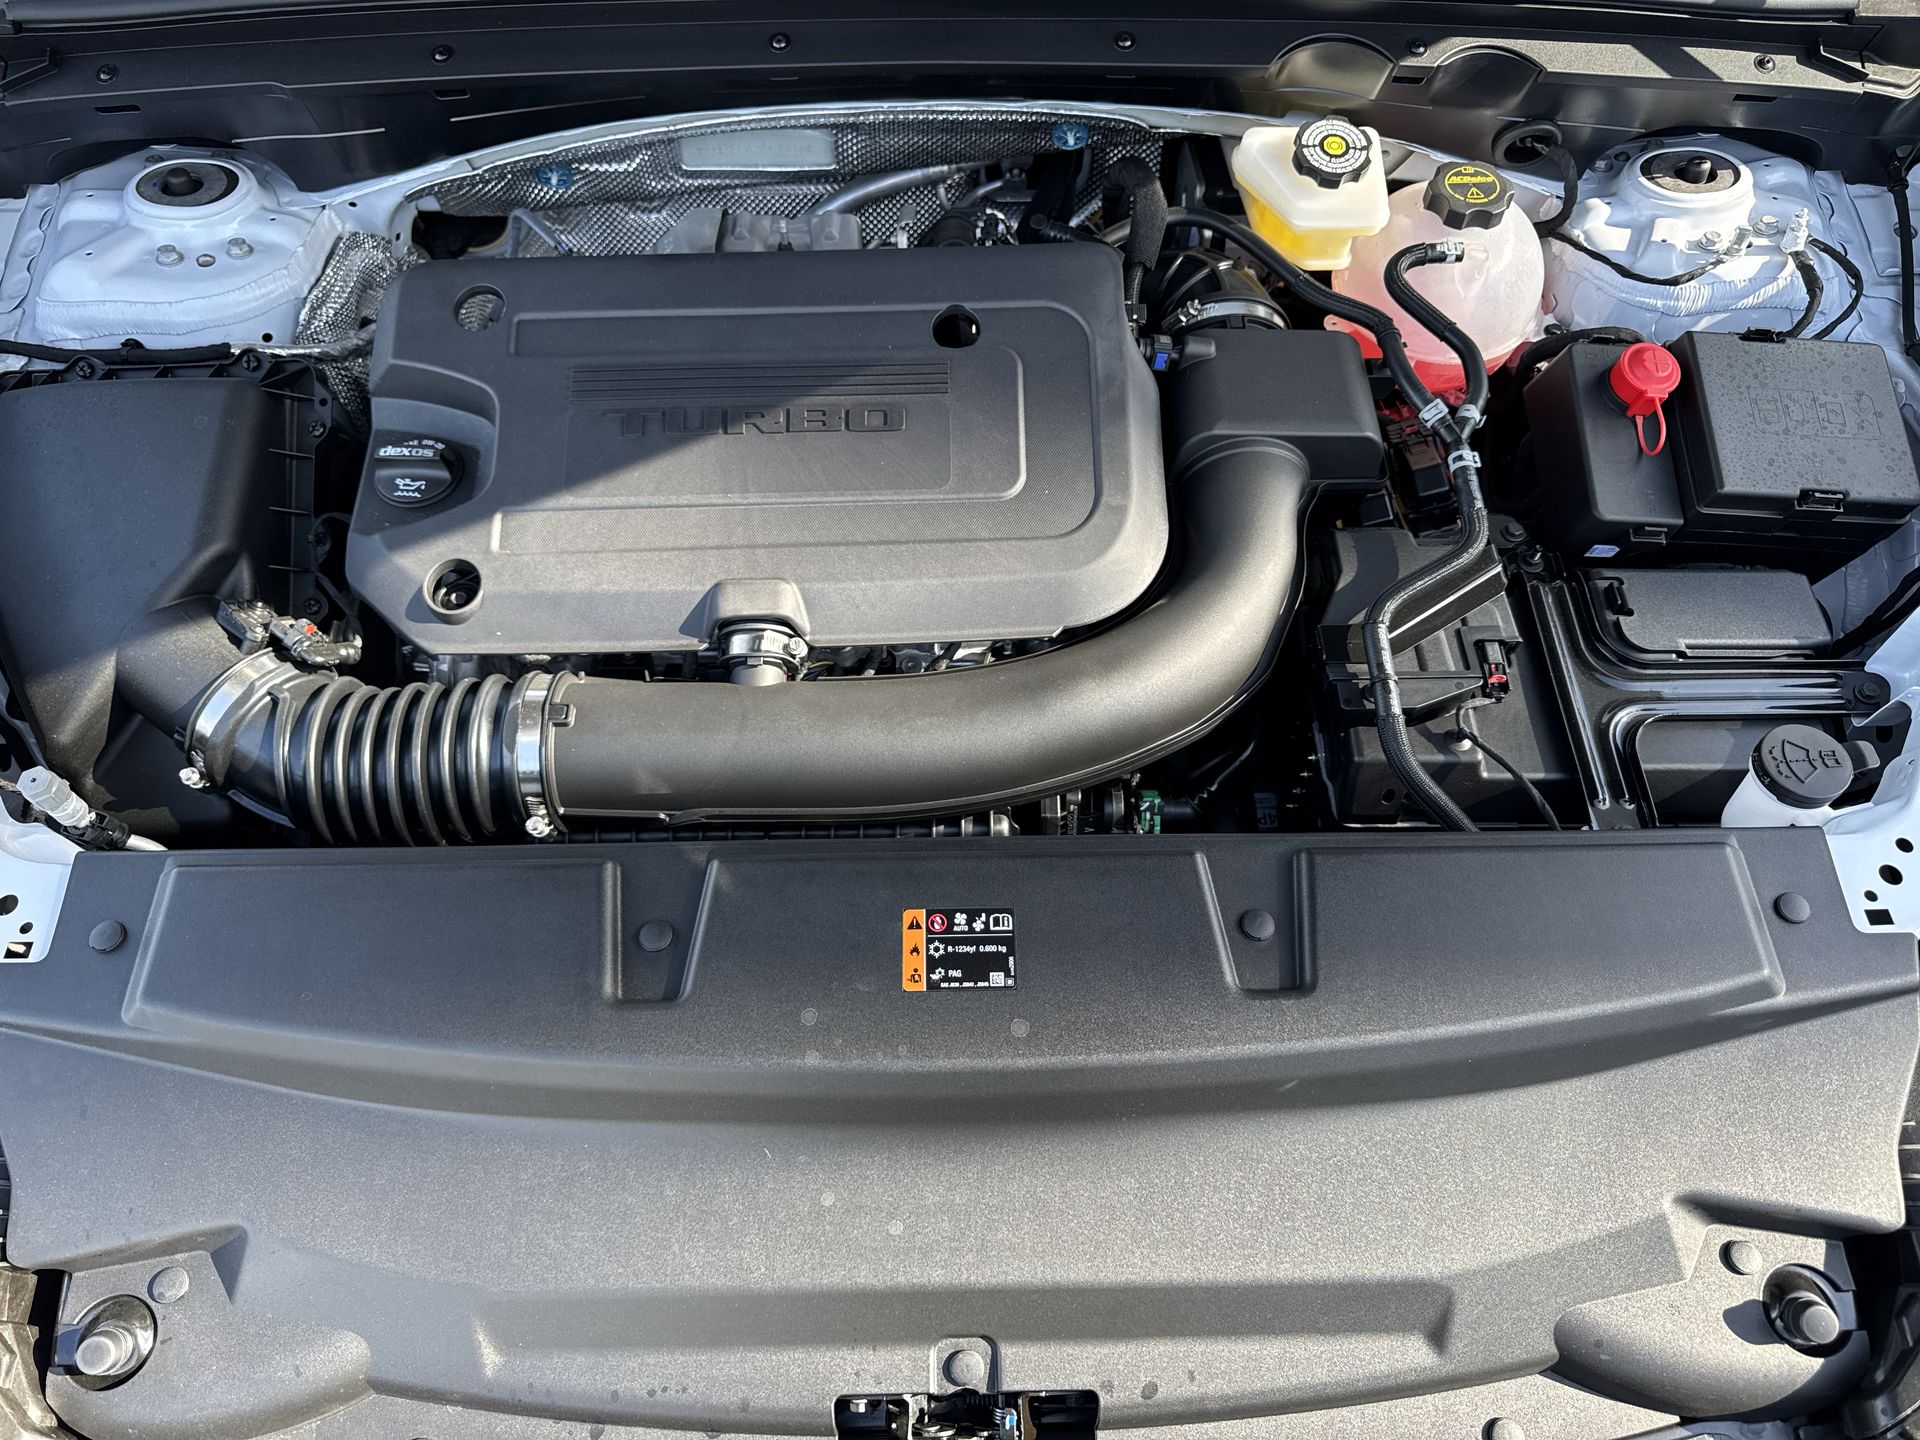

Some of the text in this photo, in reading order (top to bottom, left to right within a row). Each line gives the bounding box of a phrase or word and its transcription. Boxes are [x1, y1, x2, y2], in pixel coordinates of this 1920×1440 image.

[603, 407, 907, 437] TURBO
[379, 446, 434, 457] dexos
[947, 945, 976, 953] R-1234yf
[998, 945, 1007, 953] kg
[948, 969, 962, 977] PAG
